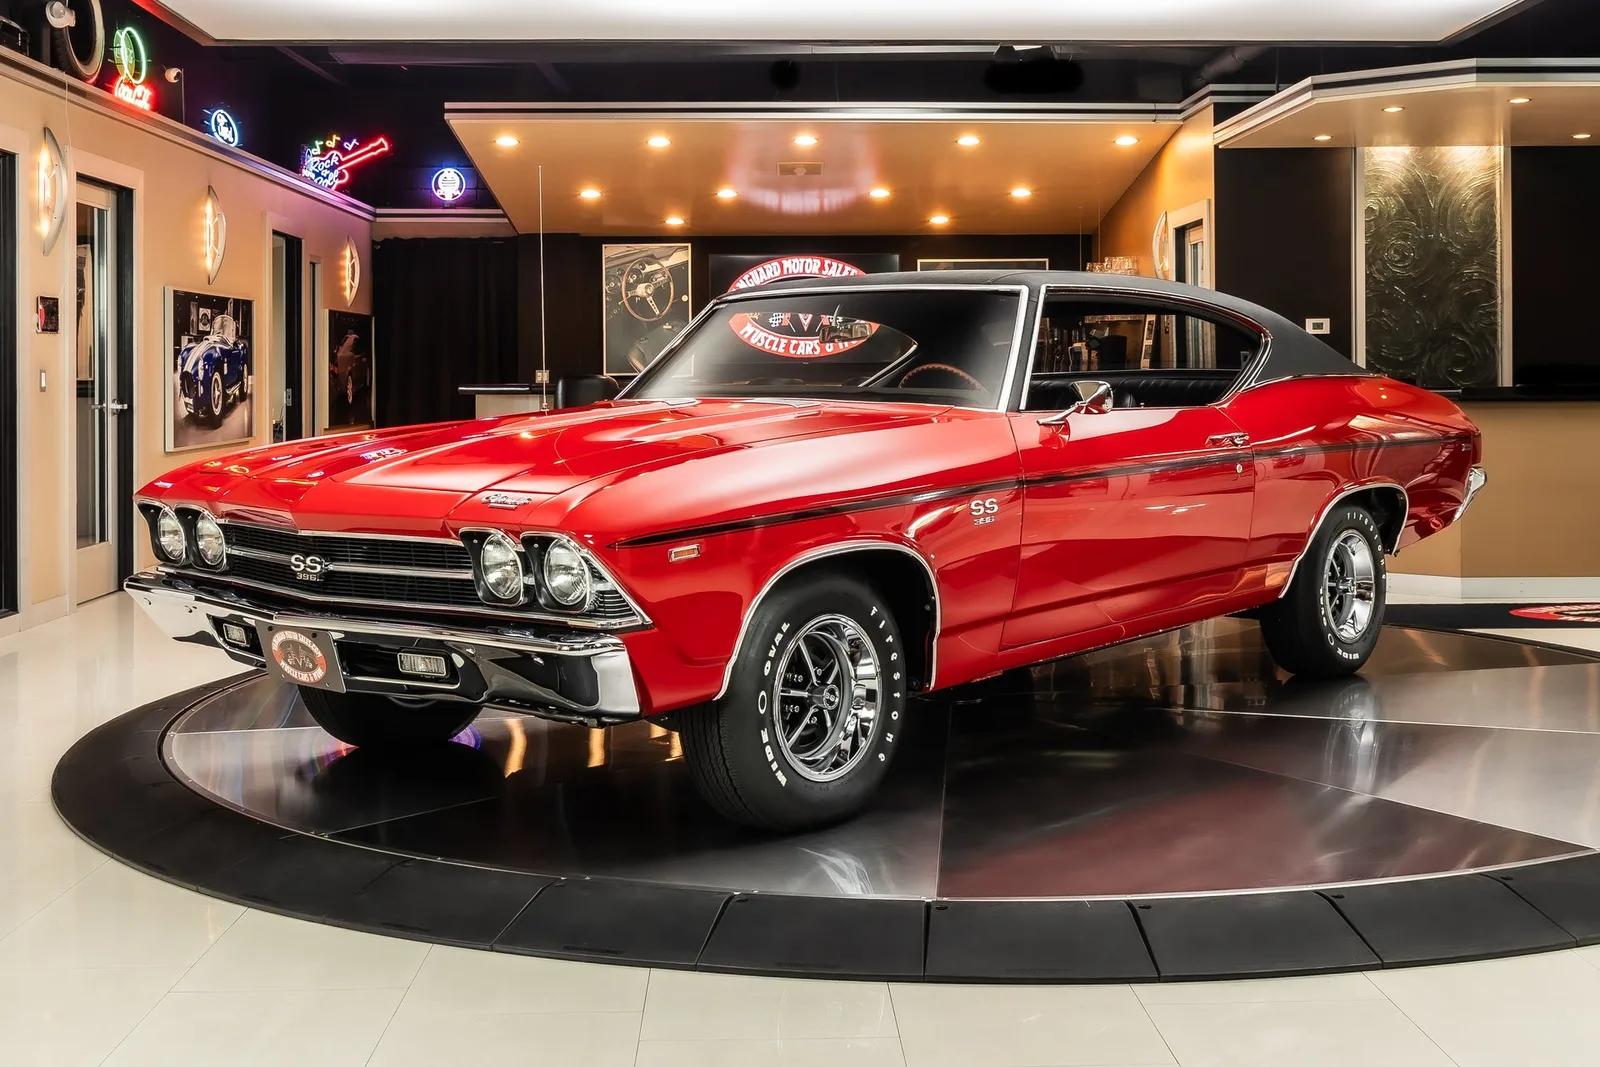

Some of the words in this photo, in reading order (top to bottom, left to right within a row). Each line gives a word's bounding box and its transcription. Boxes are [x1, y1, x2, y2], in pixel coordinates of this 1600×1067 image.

[309, 152, 339, 172] Rock
[782, 258, 820, 275] MOTOR
[739, 322, 787, 352] MUSCLE
[789, 340, 820, 355] CARS
[970, 498, 999, 516] SS
[290, 554, 321, 573] SS
[296, 572, 317, 581] 396
[764, 622, 791, 676] OVAL
[1337, 646, 1360, 660] WIDE
[760, 727, 787, 787] WIDE
